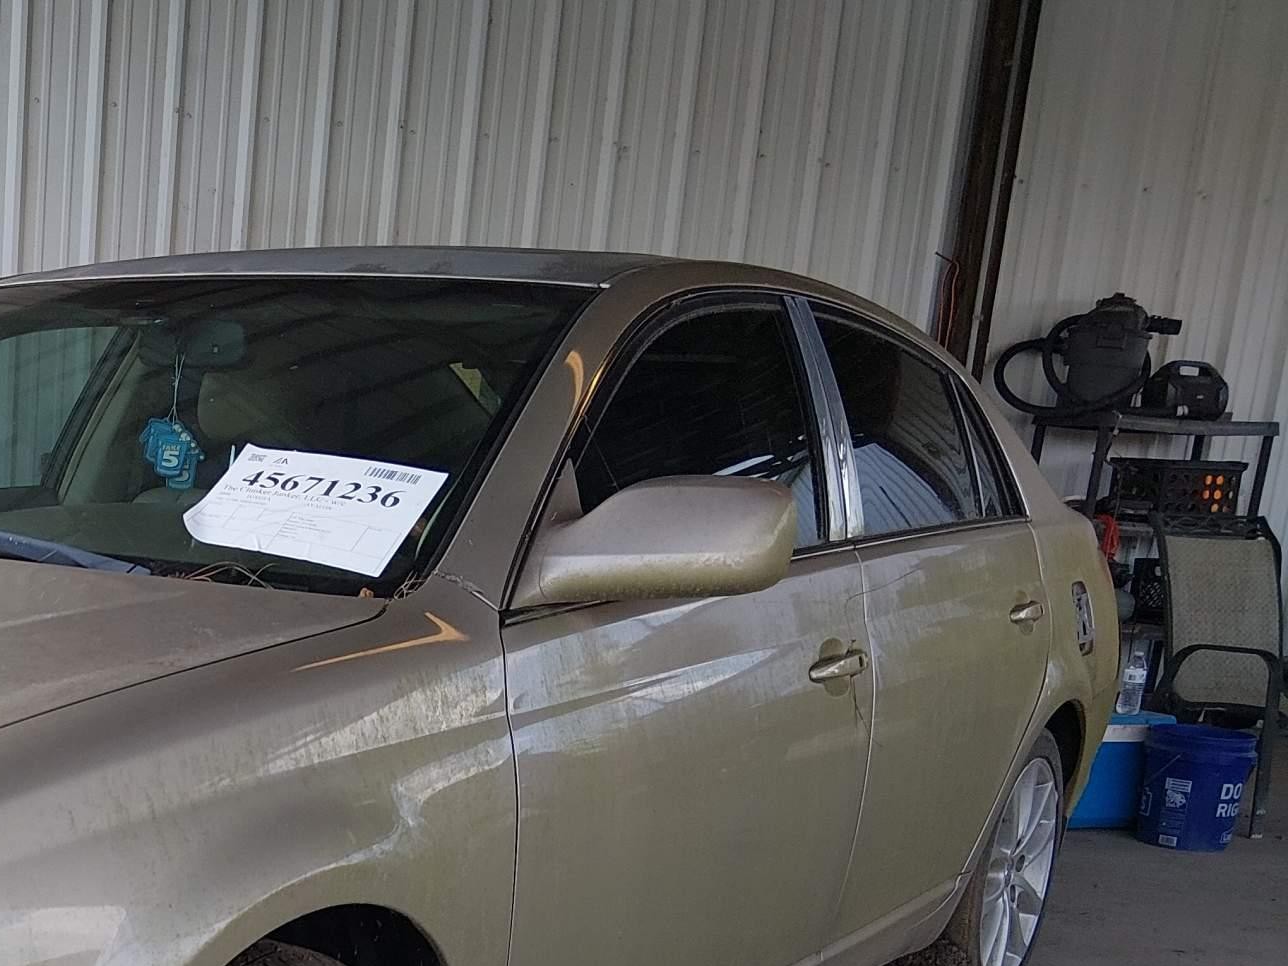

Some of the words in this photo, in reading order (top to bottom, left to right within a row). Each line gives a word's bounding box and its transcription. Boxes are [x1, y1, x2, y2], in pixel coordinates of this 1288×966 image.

[161, 450, 180, 468] 5
[242, 470, 408, 508] 45671236
[1220, 783, 1243, 800] DO
